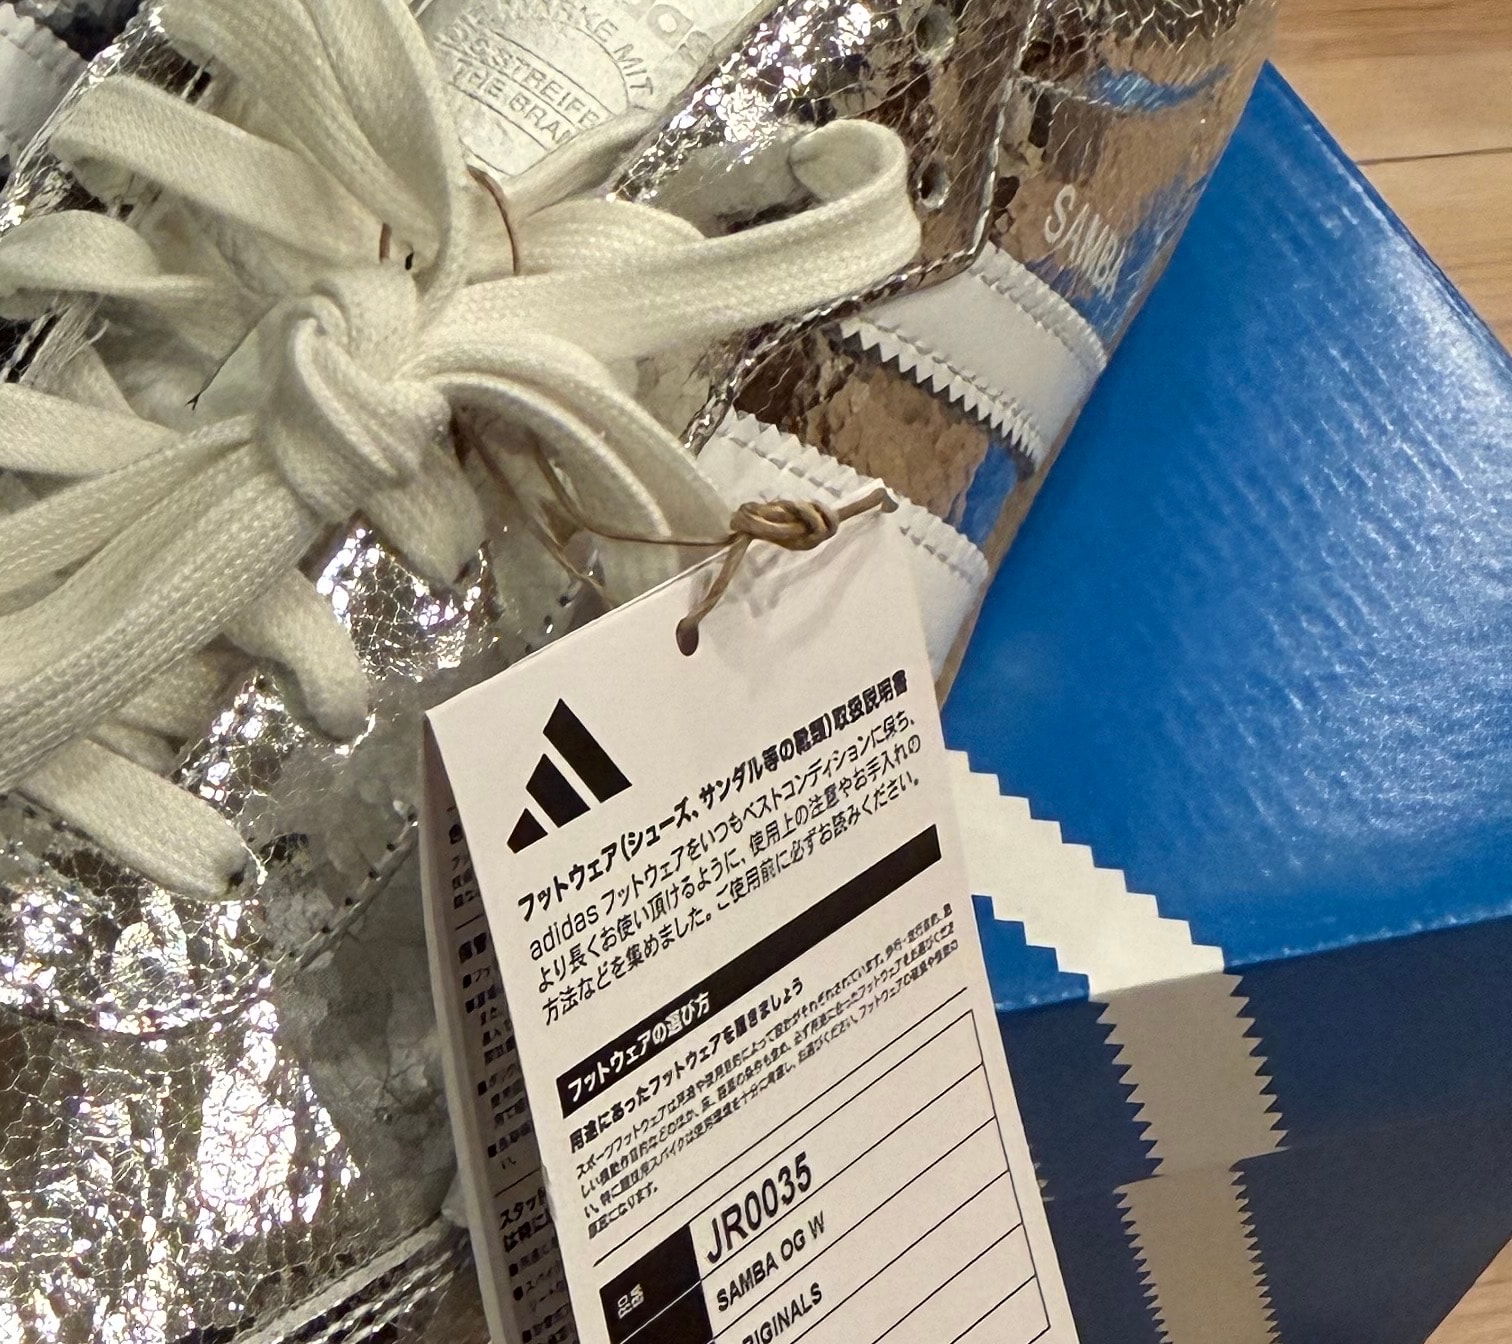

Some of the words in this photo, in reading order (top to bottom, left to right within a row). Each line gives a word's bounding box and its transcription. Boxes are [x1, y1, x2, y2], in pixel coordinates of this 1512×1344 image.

[613, 43, 655, 96] MIT
[529, 904, 599, 961] adidas
[567, 991, 710, 1102] フットウェアの選び方
[706, 1151, 812, 1264] JR0035
[716, 1251, 779, 1312] SAMBA
[780, 1228, 806, 1262] OG
[807, 1210, 825, 1240] W
